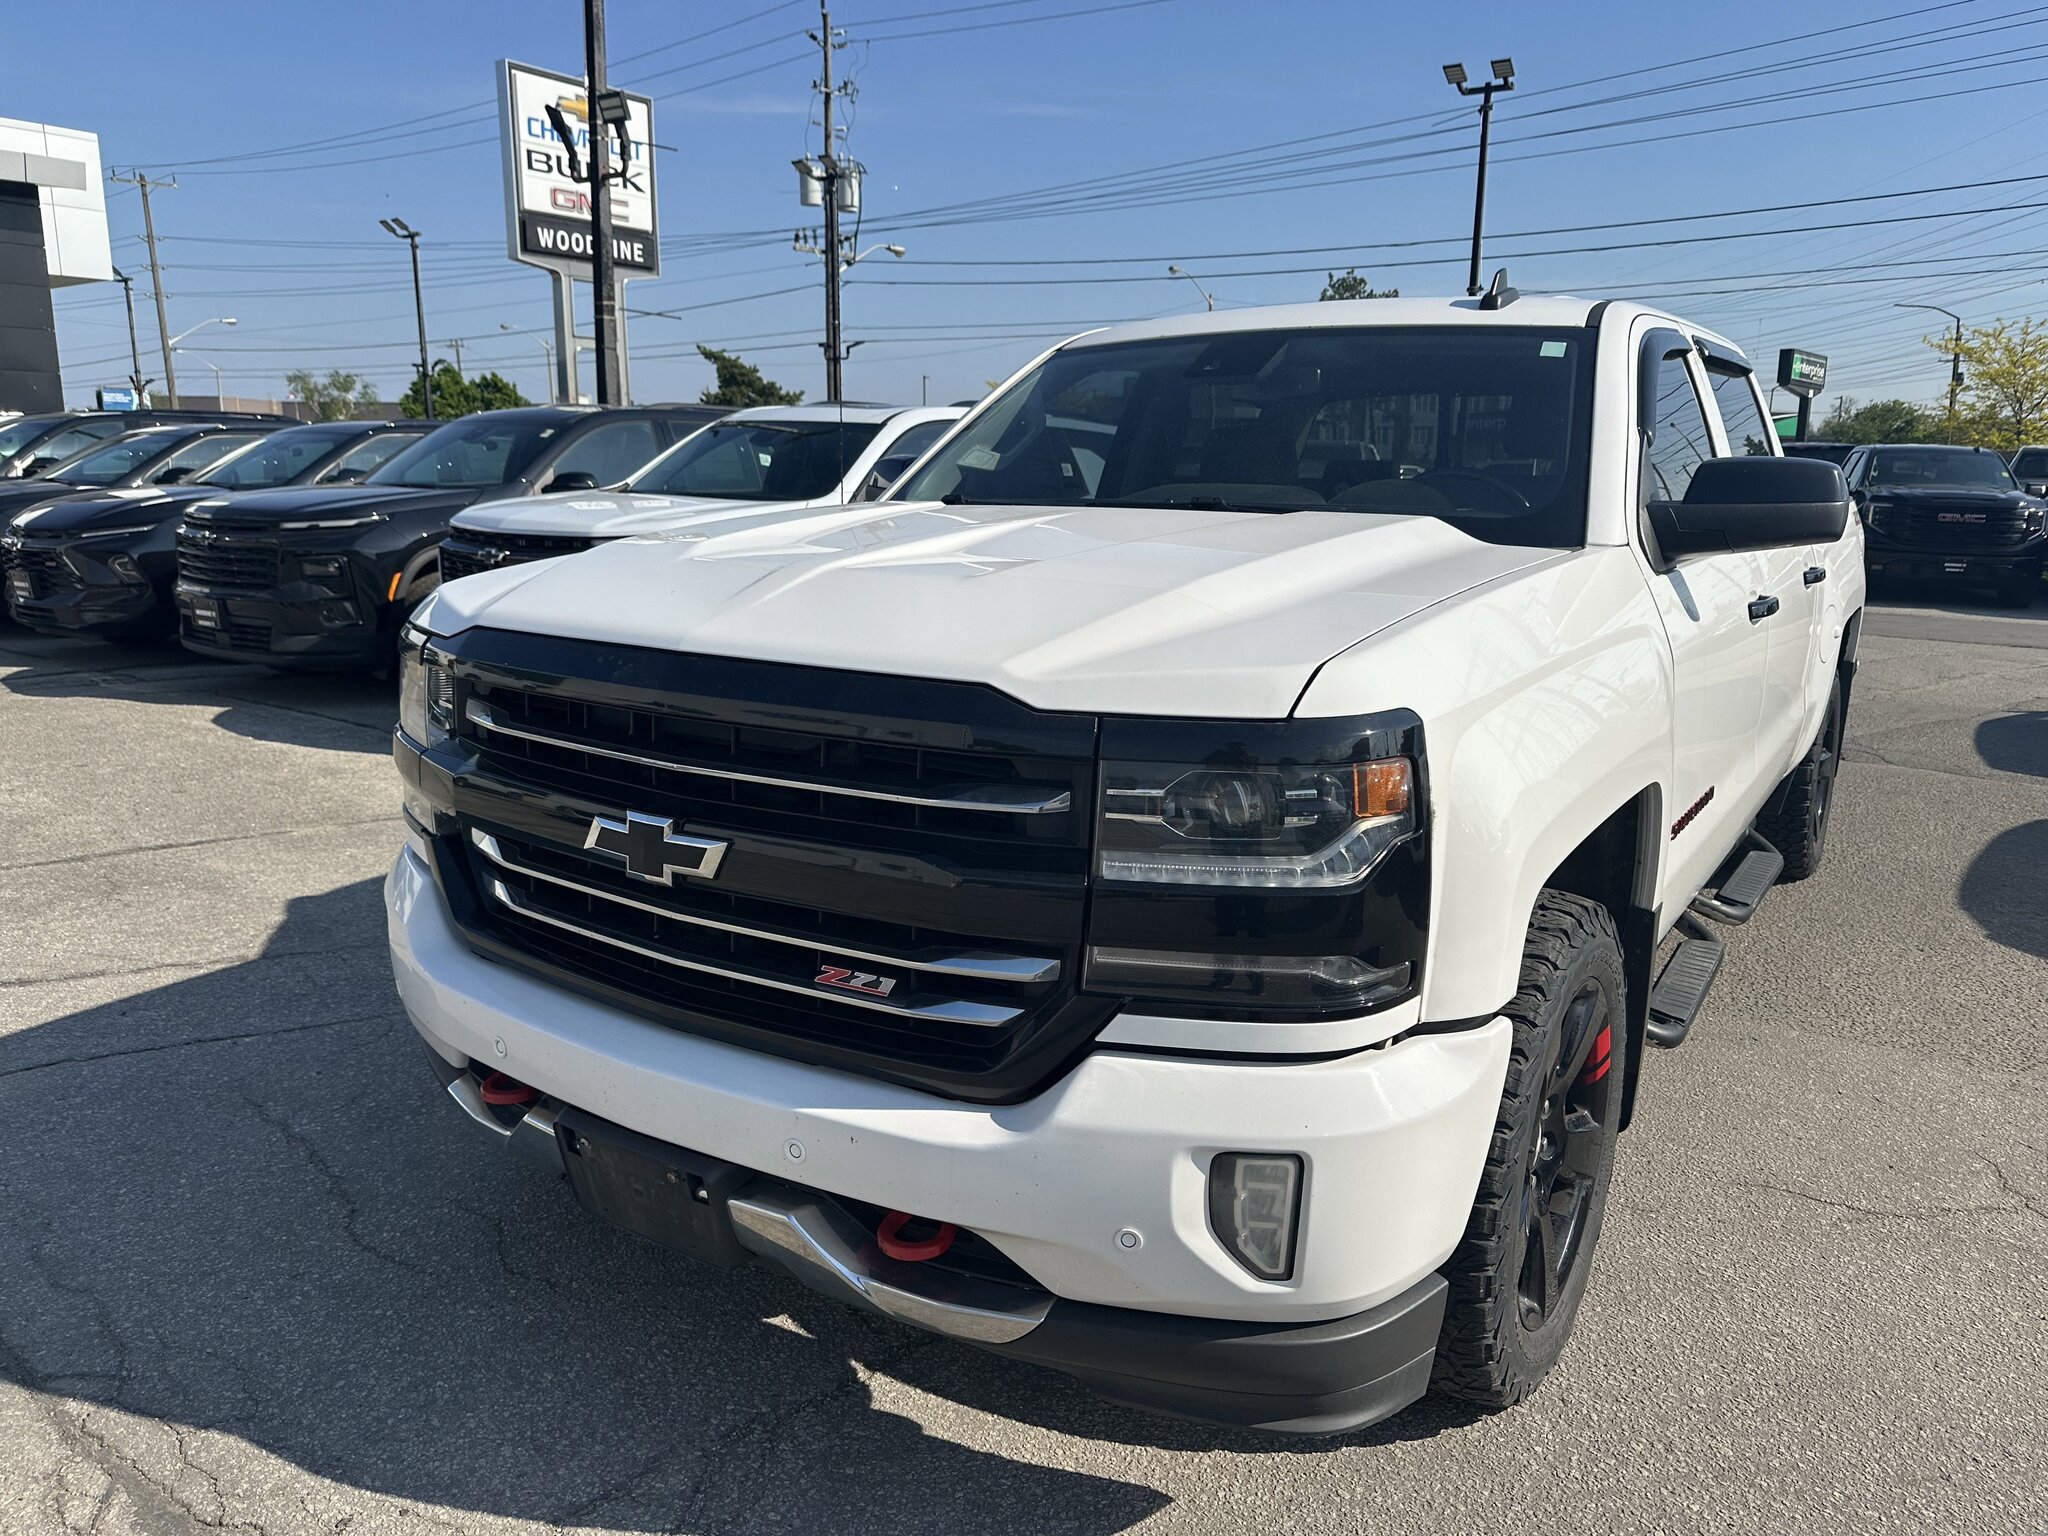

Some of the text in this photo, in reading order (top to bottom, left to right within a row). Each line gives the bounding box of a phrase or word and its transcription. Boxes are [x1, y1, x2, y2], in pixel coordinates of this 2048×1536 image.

[527, 116, 643, 161] CHVLT
[526, 148, 646, 194] BUK
[536, 226, 645, 262] WOODINE
[1793, 360, 1825, 378] enterprise
[1936, 512, 1987, 524] GMC
[814, 965, 897, 997] Z71
